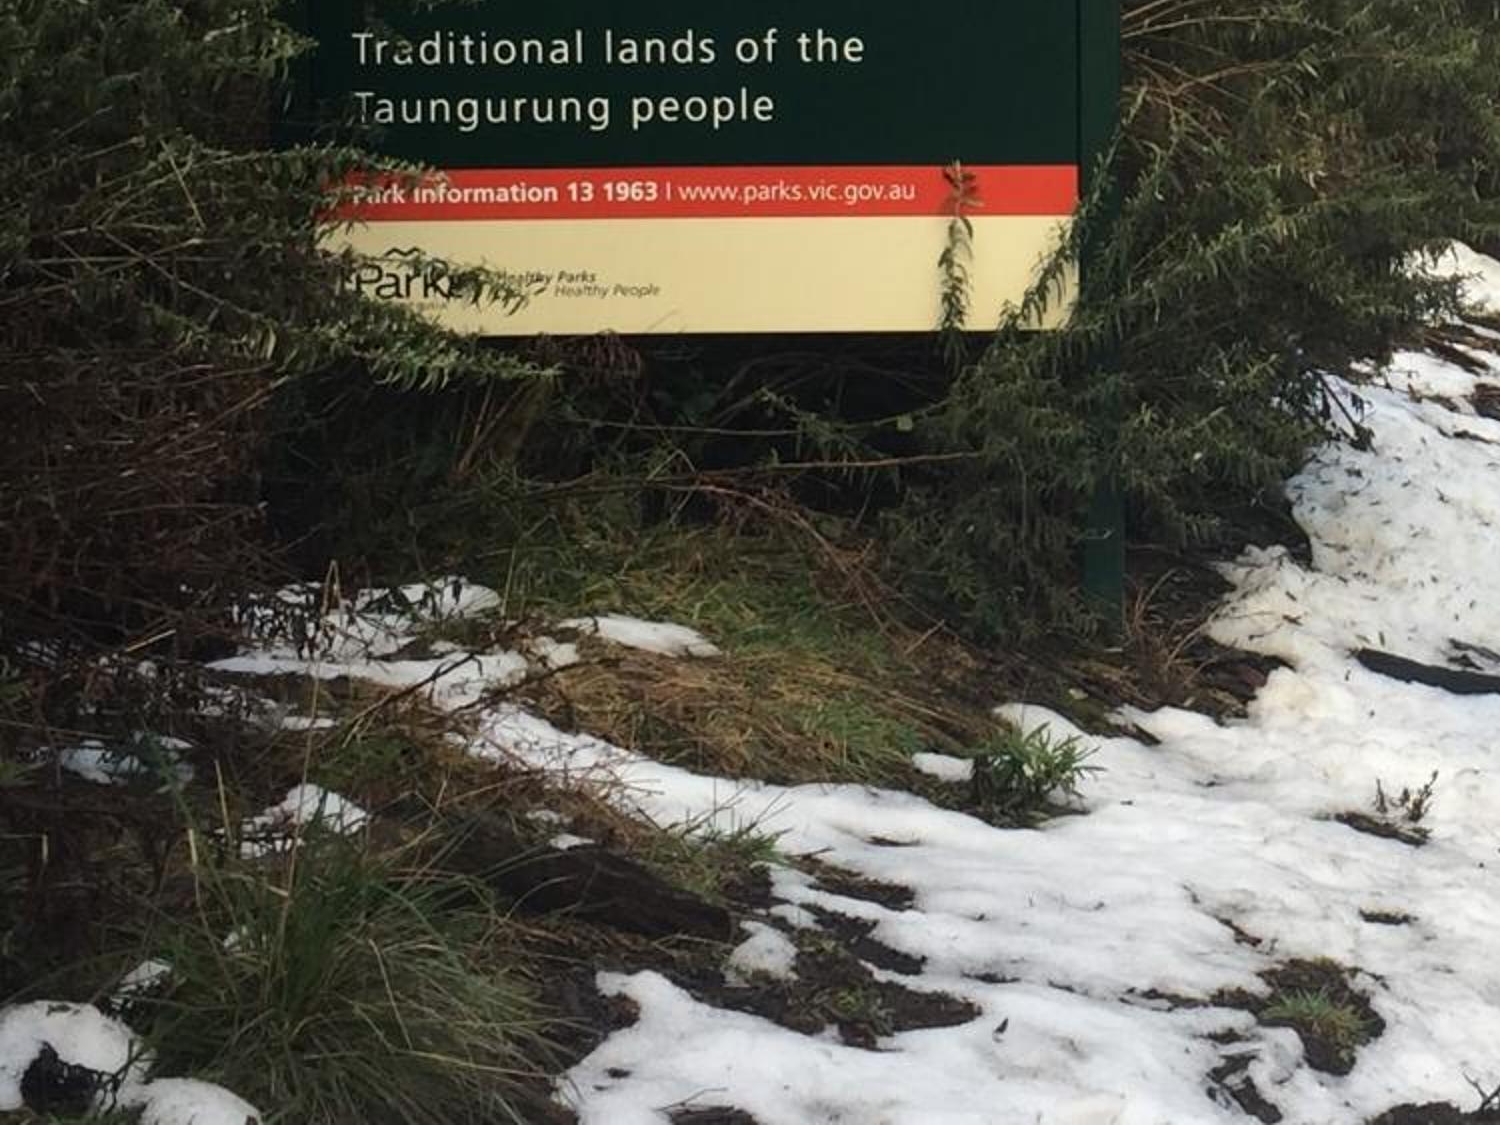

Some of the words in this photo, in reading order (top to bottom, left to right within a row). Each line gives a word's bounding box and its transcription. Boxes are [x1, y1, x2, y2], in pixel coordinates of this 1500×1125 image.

[351, 29, 584, 65] Traditional
[604, 28, 716, 64] lands
[735, 28, 778, 63] of
[797, 28, 865, 63] the
[354, 91, 610, 133] Taungurung
[631, 87, 775, 130] people
[566, 181, 595, 203] 13
[602, 180, 658, 203] 1963
[678, 178, 917, 203] www.parks.vic.gov.au
